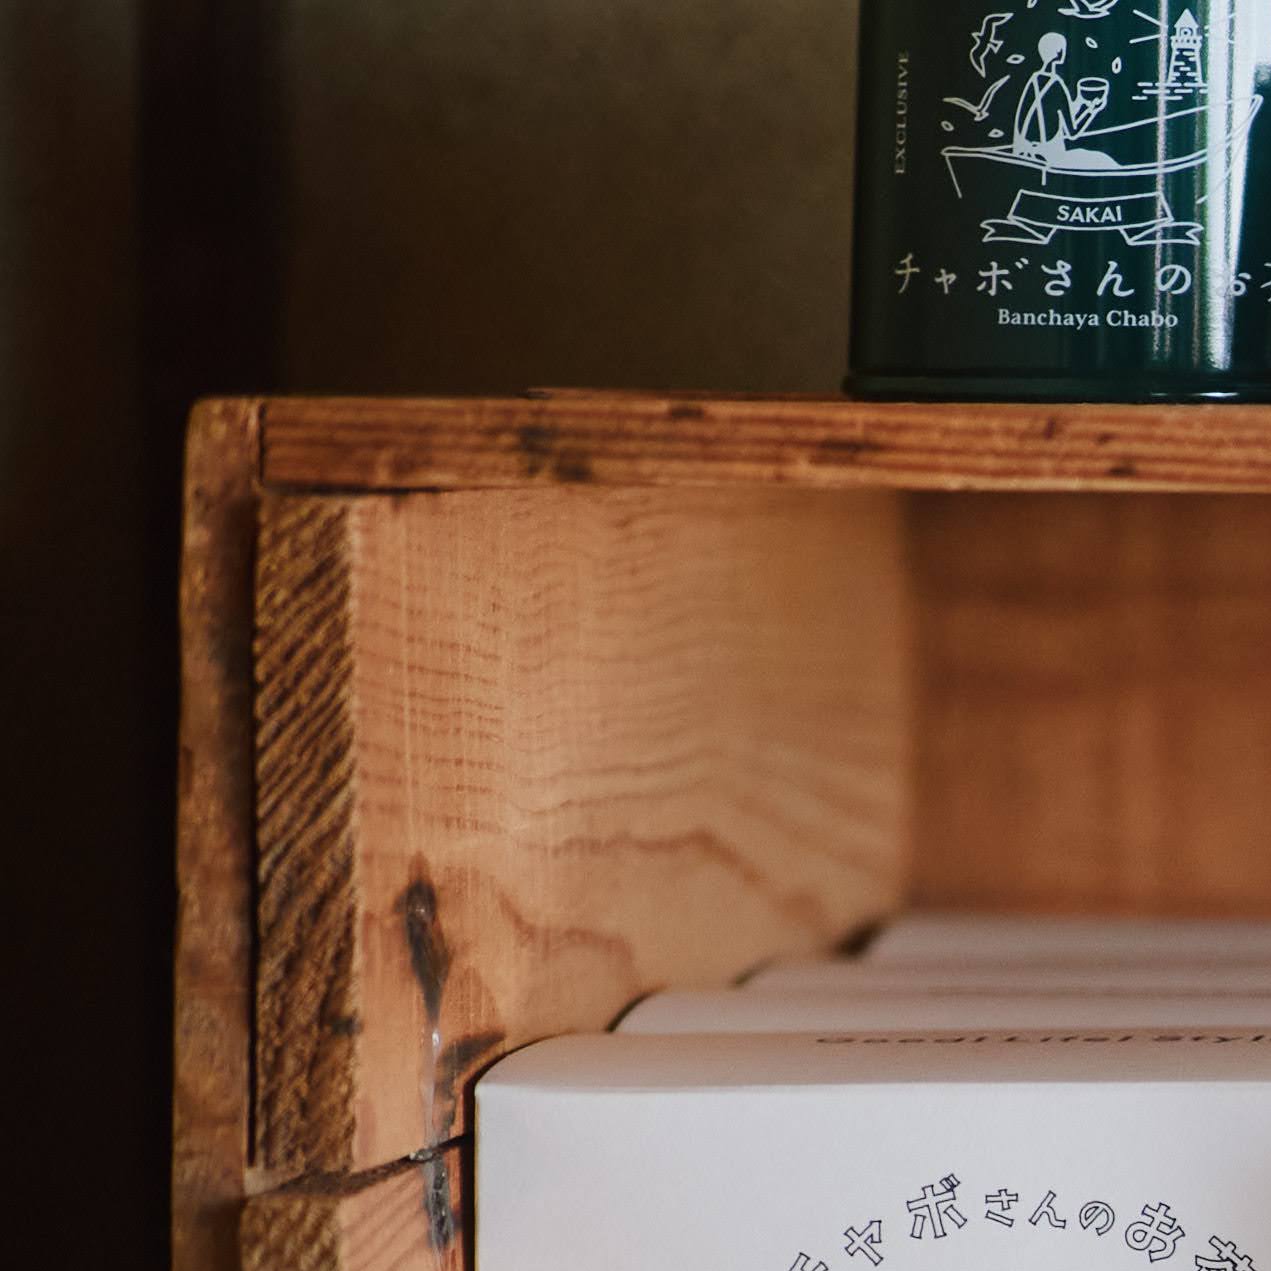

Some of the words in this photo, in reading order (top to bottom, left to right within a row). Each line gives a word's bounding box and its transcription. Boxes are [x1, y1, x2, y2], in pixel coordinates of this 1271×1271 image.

[895, 51, 910, 175] EXCLUSIVE
[1056, 204, 1123, 224] SAKAI
[998, 308, 1100, 330] Banchaya
[1104, 308, 1180, 330] Chabo
